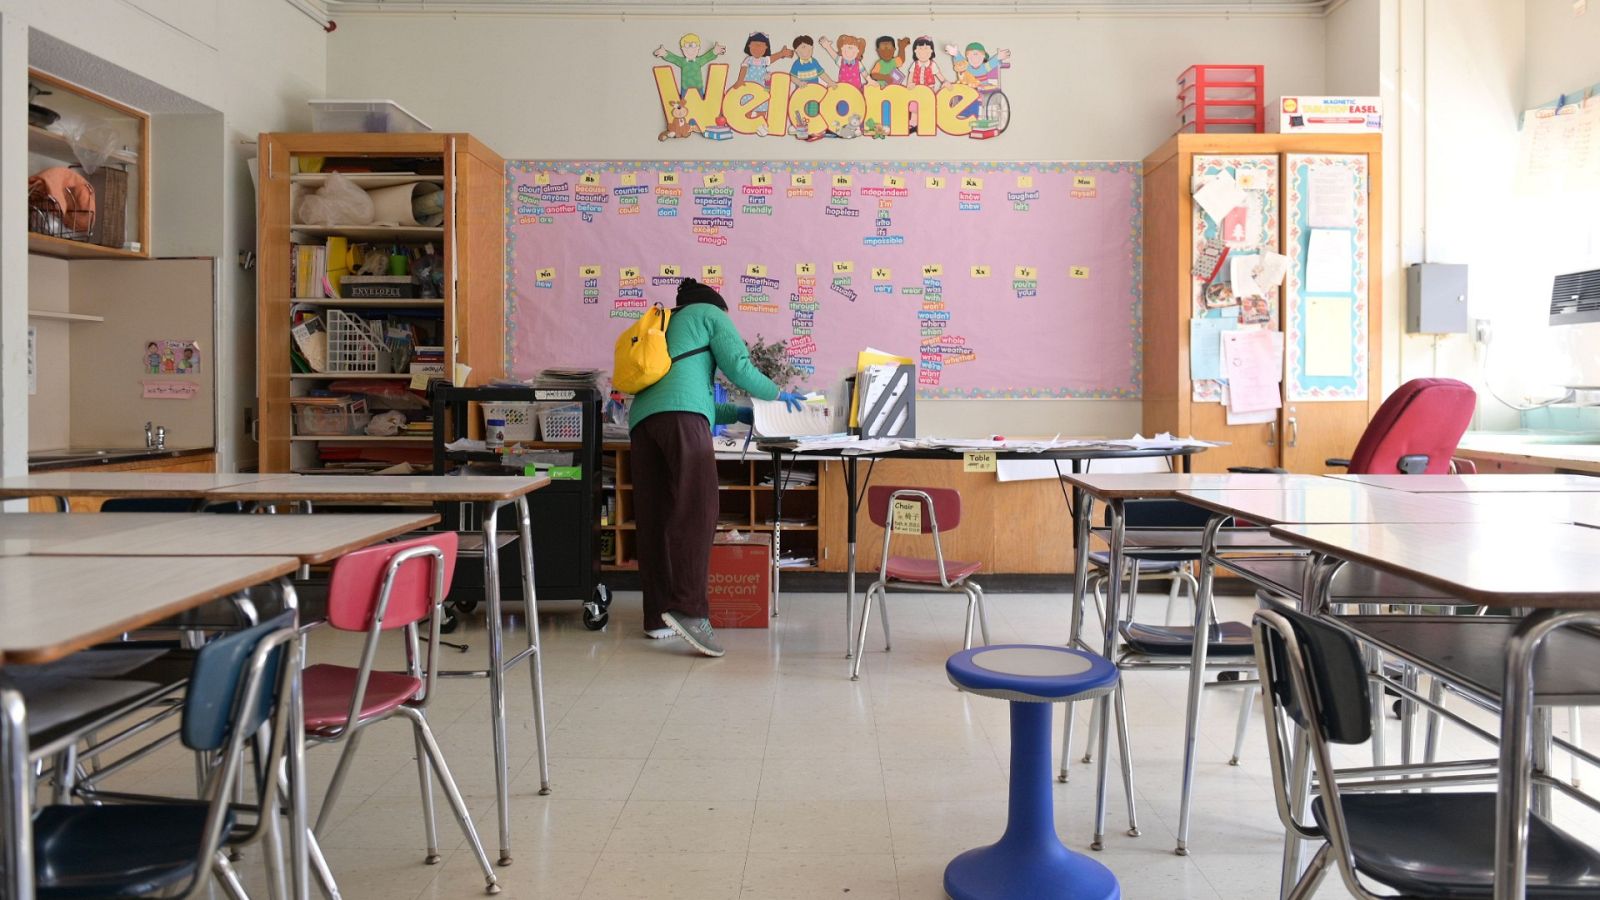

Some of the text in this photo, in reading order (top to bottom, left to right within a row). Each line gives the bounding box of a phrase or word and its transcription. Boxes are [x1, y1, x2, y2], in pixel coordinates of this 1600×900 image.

[653, 62, 980, 137] Welcome
[1349, 105, 1377, 113] EASEL
[931, 178, 940, 187] Jj
[518, 183, 568, 195] about almost
[614, 186, 649, 196] countries
[693, 187, 734, 197] everybody
[743, 186, 772, 195] favorite
[832, 188, 851, 197] have
[861, 188, 908, 199] independent
[518, 193, 569, 204] again anyone
[575, 194, 609, 204] beautiful
[749, 196, 765, 204] first
[960, 191, 980, 200] know
[1008, 191, 1039, 202] laughed
[620, 196, 639, 205] can't
[657, 196, 679, 206] didn't
[695, 196, 732, 207] especially
[518, 204, 576, 215] always another
[577, 203, 603, 212] before
[620, 206, 640, 215] could
[658, 207, 678, 216] don't
[702, 207, 732, 216] exciting
[743, 205, 772, 215] friendly
[582, 212, 593, 222] by
[826, 207, 860, 218] hopeless
[520, 214, 553, 223] also are
[693, 217, 734, 229] everything
[693, 227, 720, 236] except
[698, 236, 728, 246] enough
[863, 236, 904, 247] impossible
[664, 267, 674, 275] Qq
[535, 281, 552, 289] new
[585, 279, 598, 287] off
[620, 278, 646, 287] people
[740, 276, 779, 288] something
[833, 277, 852, 286] until
[923, 279, 941, 287] who
[584, 289, 599, 297] one
[619, 289, 643, 298] pretty
[745, 285, 763, 293] said
[799, 286, 814, 294] two
[831, 283, 857, 302] usually
[1017, 289, 1037, 298] your
[741, 294, 769, 303] schools
[791, 293, 799, 301] to
[615, 300, 647, 309] prettiest
[790, 302, 819, 310] through
[922, 302, 945, 310] won't
[609, 310, 645, 320] probabl
[918, 311, 950, 320] wouldn't
[941, 336, 965, 345] whole
[920, 346, 973, 355] what weather
[894, 502, 913, 510] Chair
[707, 572, 761, 585] abouret
